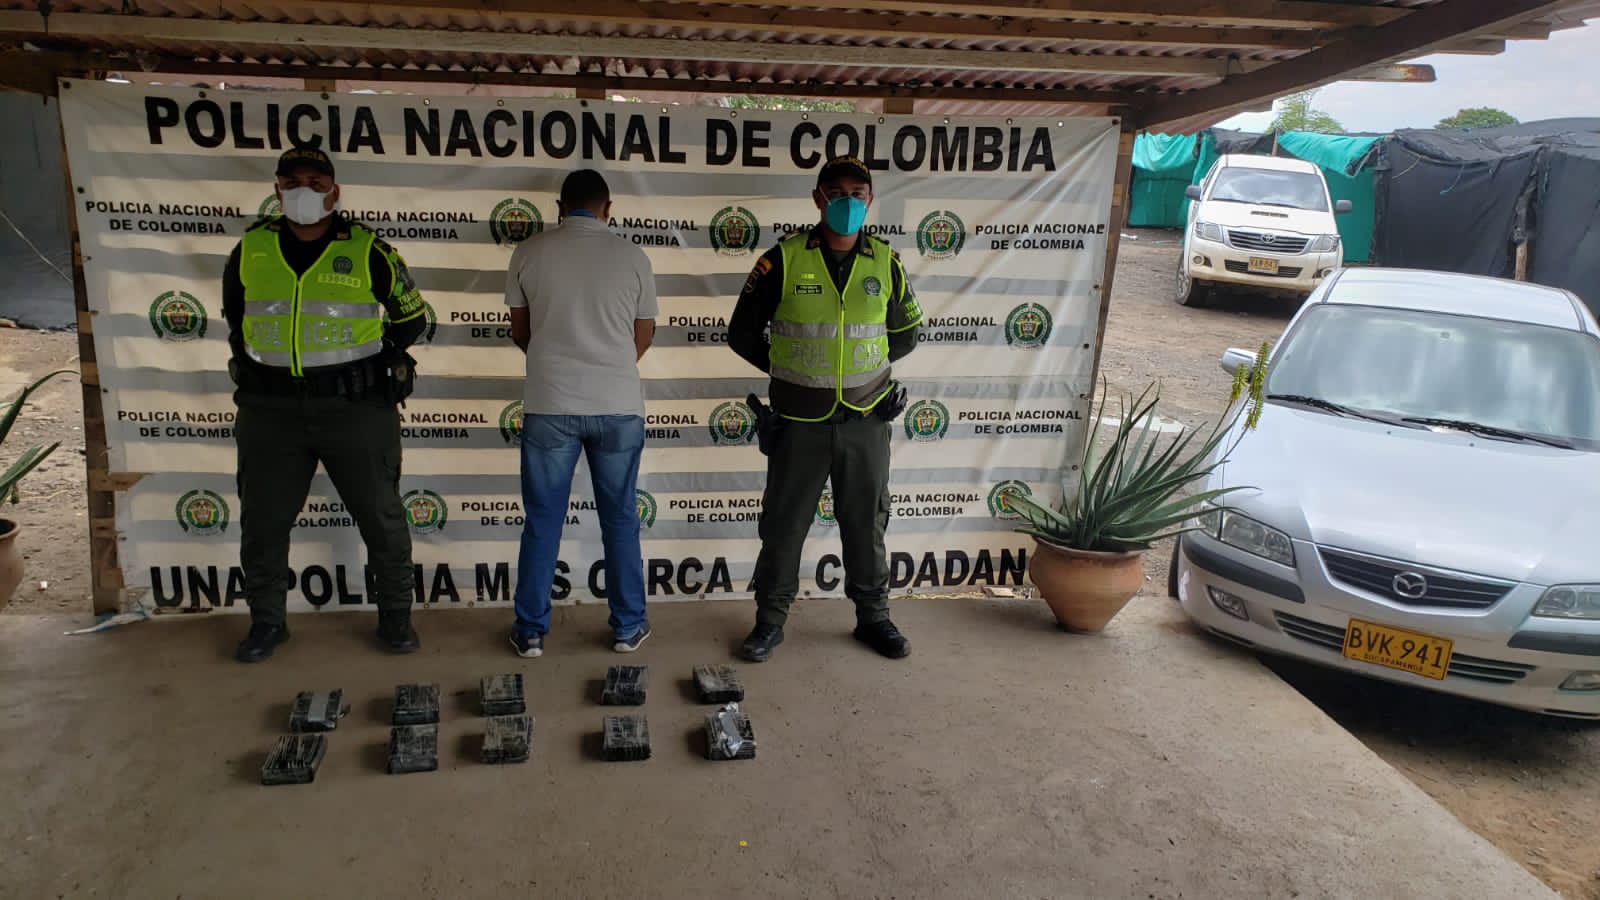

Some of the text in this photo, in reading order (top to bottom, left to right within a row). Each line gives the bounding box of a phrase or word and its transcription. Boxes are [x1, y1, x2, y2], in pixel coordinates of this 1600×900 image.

[144, 96, 1056, 172] POLICIA NACIONAL DE COLOMBIA
[86, 201, 245, 218] POLICIA NACIONAL
[340, 209, 477, 223] OLICIA NACIONAL
[109, 219, 225, 233] DE COLOMBIA
[623, 218, 698, 231] NACIONAL
[975, 225, 1029, 235] POLICIA
[375, 228, 458, 239] COLOMBIA
[991, 240, 1084, 250] DE COLOMBIA
[451, 312, 512, 322] POLICIA
[669, 317, 725, 327] POLICIA
[928, 316, 997, 327] NACIONAL
[251, 321, 353, 346] POLICIA
[471, 328, 490, 338] DE
[688, 332, 704, 342] DE
[918, 332, 978, 342] OLOMBIA
[117, 411, 234, 423] POLICIA NACIO
[411, 413, 488, 424] NACIONAL
[646, 415, 699, 425] CIONAL
[959, 410, 1082, 421] POLICIA NACIONAL
[140, 427, 236, 438] DE COLOMBI
[401, 429, 469, 439] OLOMBIA
[975, 424, 1063, 435] DE COLOMBIA
[916, 494, 981, 504] NACIONAL
[461, 502, 519, 512] POLICIA
[670, 500, 723, 510] POLICIA
[687, 512, 763, 523] DE COLOM
[897, 507, 964, 518] COLOMBIA
[480, 516, 499, 526] DE
[150, 565, 249, 607] UNA
[475, 562, 571, 602] MS
[588, 557, 733, 599] CRCA
[1351, 627, 1443, 668] BVK 941
